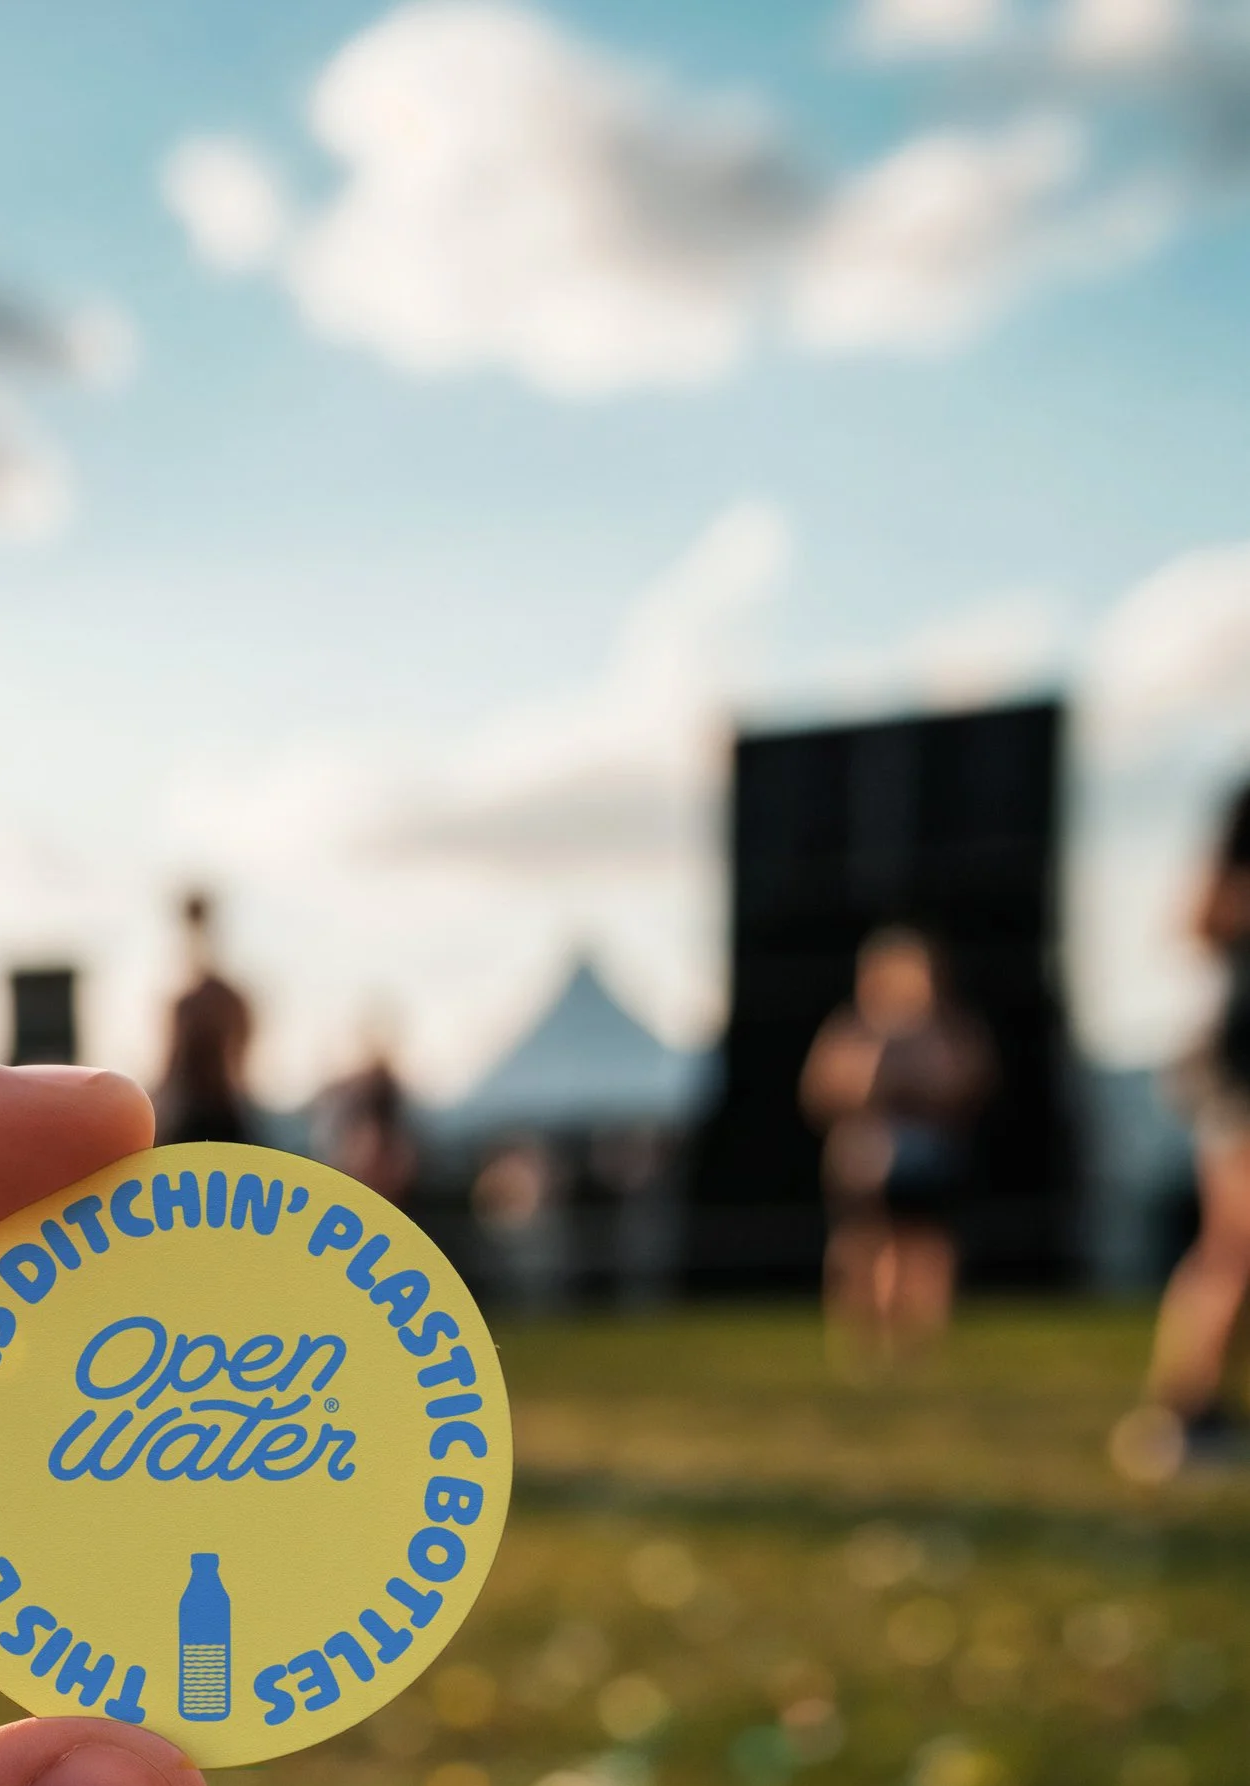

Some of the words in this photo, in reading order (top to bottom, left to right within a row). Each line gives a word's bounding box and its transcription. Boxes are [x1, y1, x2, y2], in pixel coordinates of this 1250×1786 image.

[75, 1315, 347, 1410] Open
[307, 1204, 488, 1460] PLASTIC
[253, 1475, 484, 1726] BOTTLES
